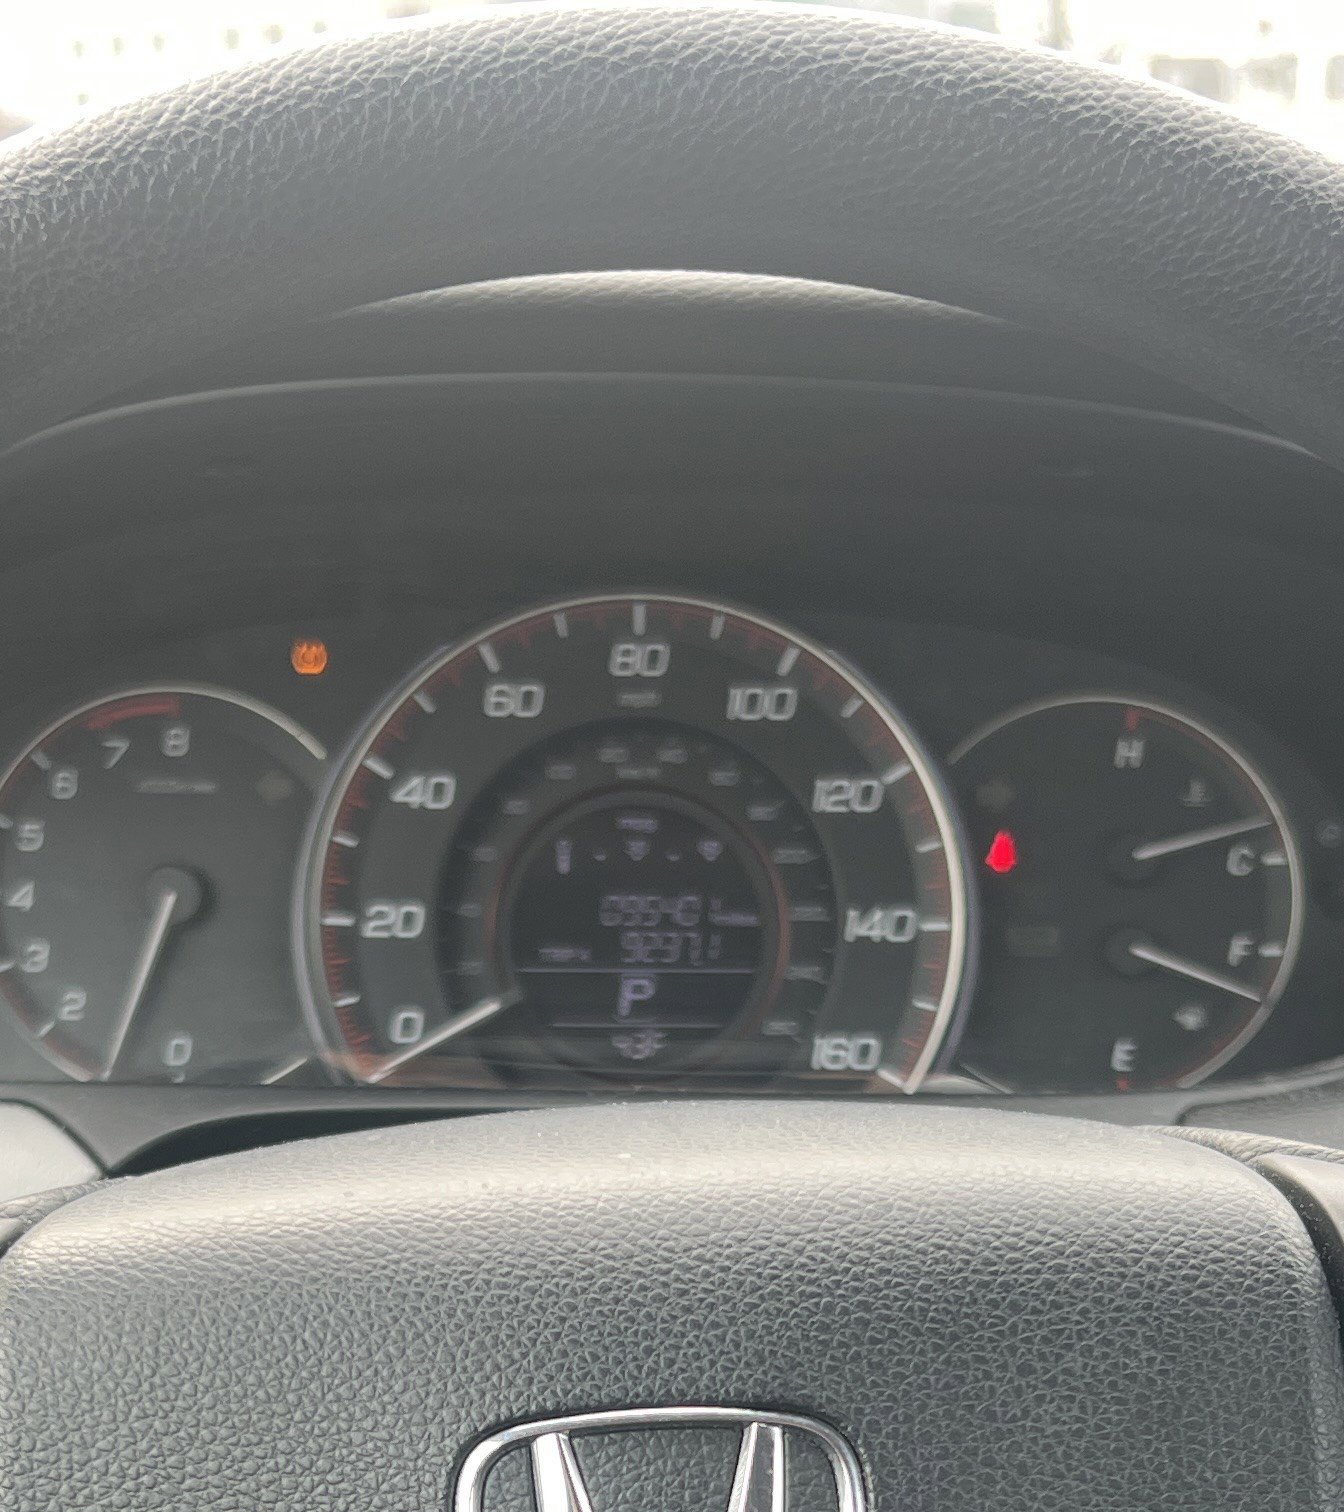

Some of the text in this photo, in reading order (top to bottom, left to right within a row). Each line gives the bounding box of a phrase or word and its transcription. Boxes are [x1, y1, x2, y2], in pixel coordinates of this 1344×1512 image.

[609, 643, 670, 677] 80
[483, 684, 544, 718] 60
[727, 687, 797, 721] 100
[100, 739, 130, 769] 7
[161, 727, 191, 757] 8
[1114, 738, 1145, 768] H
[52, 767, 78, 799] 6
[392, 775, 455, 809] 40
[813, 779, 882, 813] 120
[16, 819, 45, 851] 5
[7, 882, 35, 912] 4
[361, 905, 425, 939] 20
[844, 910, 916, 942] 140
[21, 938, 50, 973] 3
[58, 987, 87, 1021] 2
[617, 978, 656, 1017] P
[389, 1012, 423, 1044] 0
[164, 1033, 193, 1066] 0
[811, 1037, 880, 1071] 160
[1111, 1037, 1137, 1072] E
